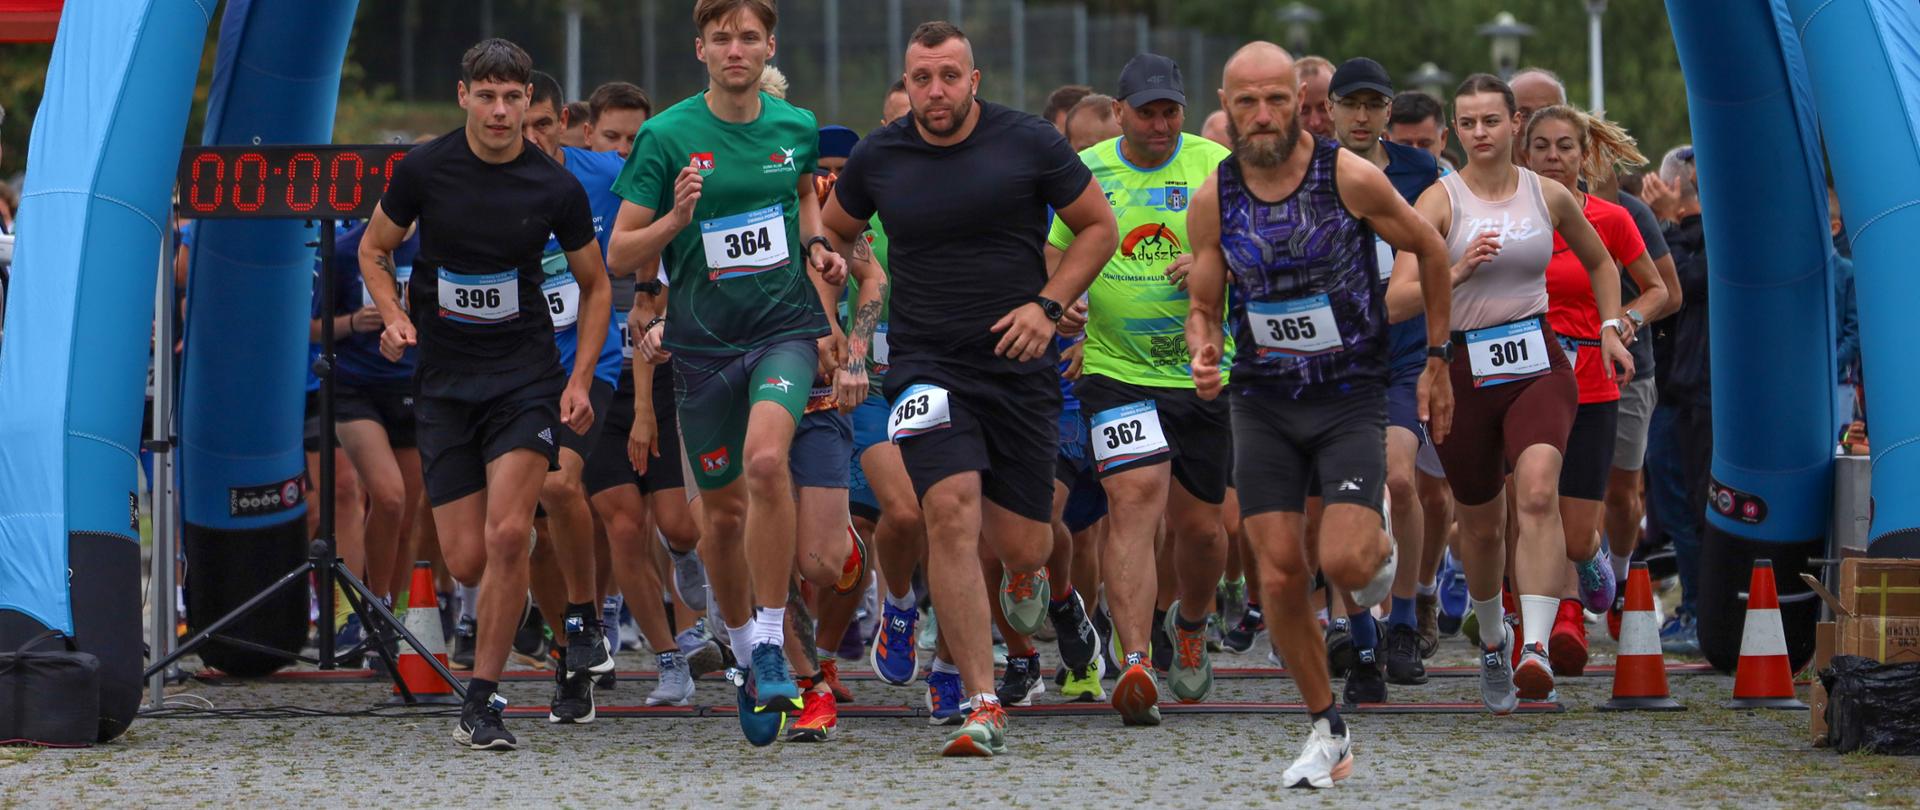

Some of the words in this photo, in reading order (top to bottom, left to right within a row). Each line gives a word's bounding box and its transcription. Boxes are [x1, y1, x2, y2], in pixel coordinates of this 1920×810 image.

[724, 226, 772, 259] 364
[455, 288, 501, 309] 396
[547, 291, 565, 315] 5
[1266, 316, 1317, 341] 365
[1489, 338, 1529, 367] 301
[895, 394, 930, 427] 363
[1103, 419, 1147, 450] 362
